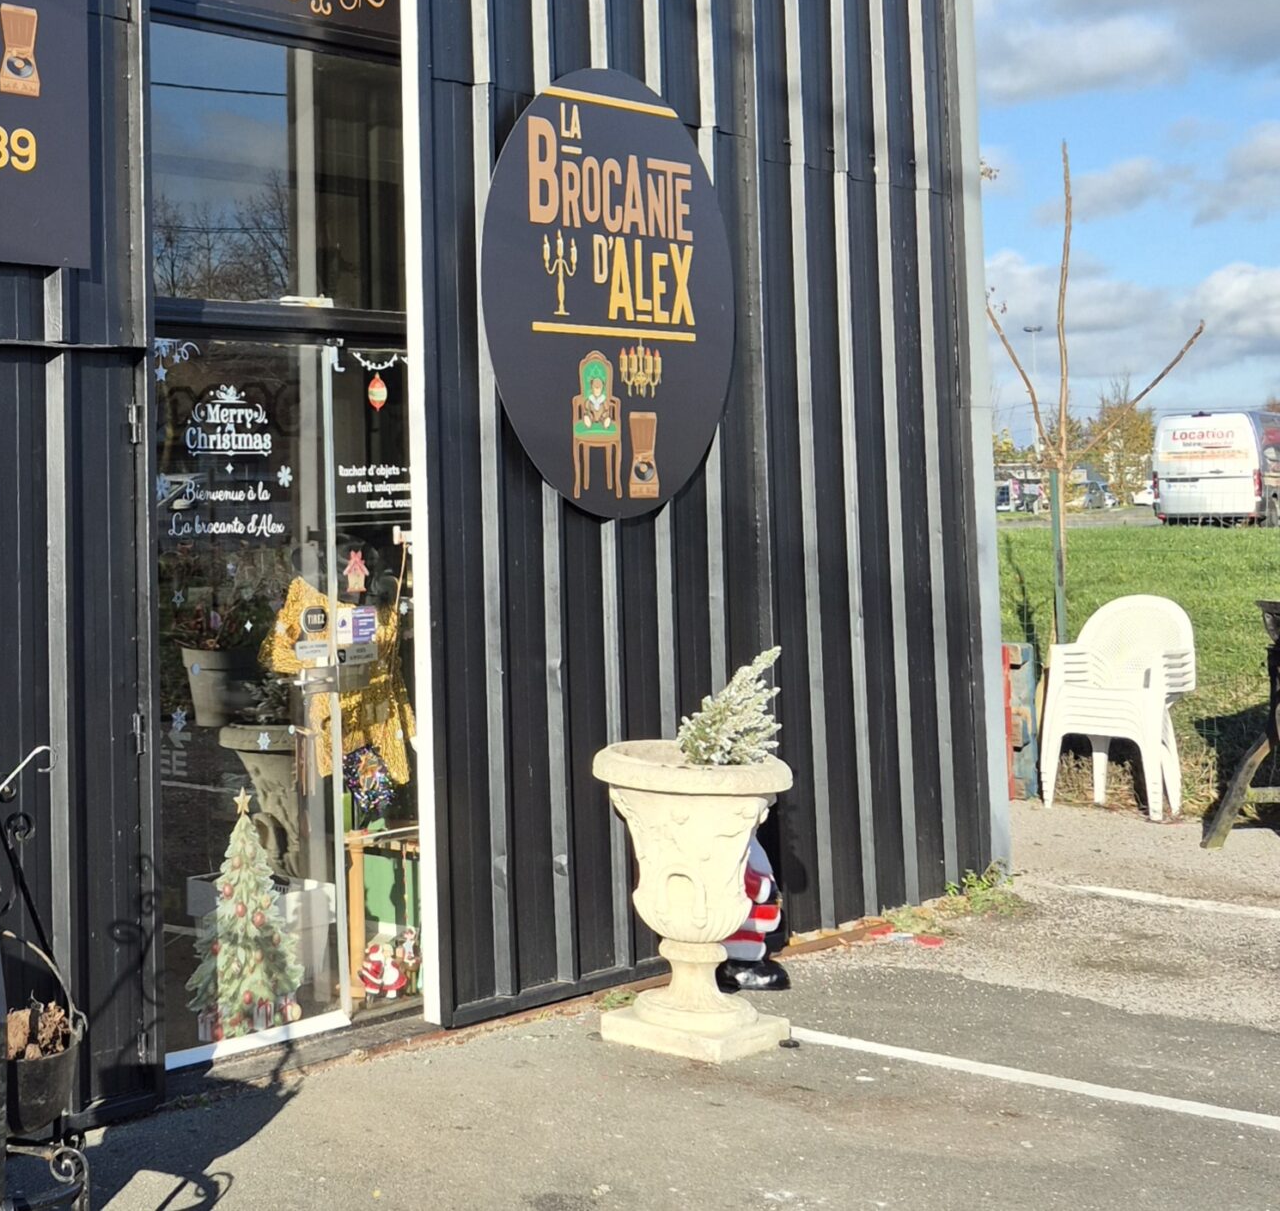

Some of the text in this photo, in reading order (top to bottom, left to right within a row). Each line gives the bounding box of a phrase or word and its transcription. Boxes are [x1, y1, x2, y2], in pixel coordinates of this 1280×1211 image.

[561, 103, 581, 139] LA
[528, 115, 693, 241] BROCANTE
[206, 404, 255, 429] Merry
[186, 426, 272, 450] Christmas
[1172, 429, 1235, 441] Location
[183, 479, 271, 503] Bienvenue à la
[357, 481, 373, 493] fait
[366, 497, 393, 509] rendez
[168, 512, 192, 536] La
[194, 515, 245, 534] brocante
